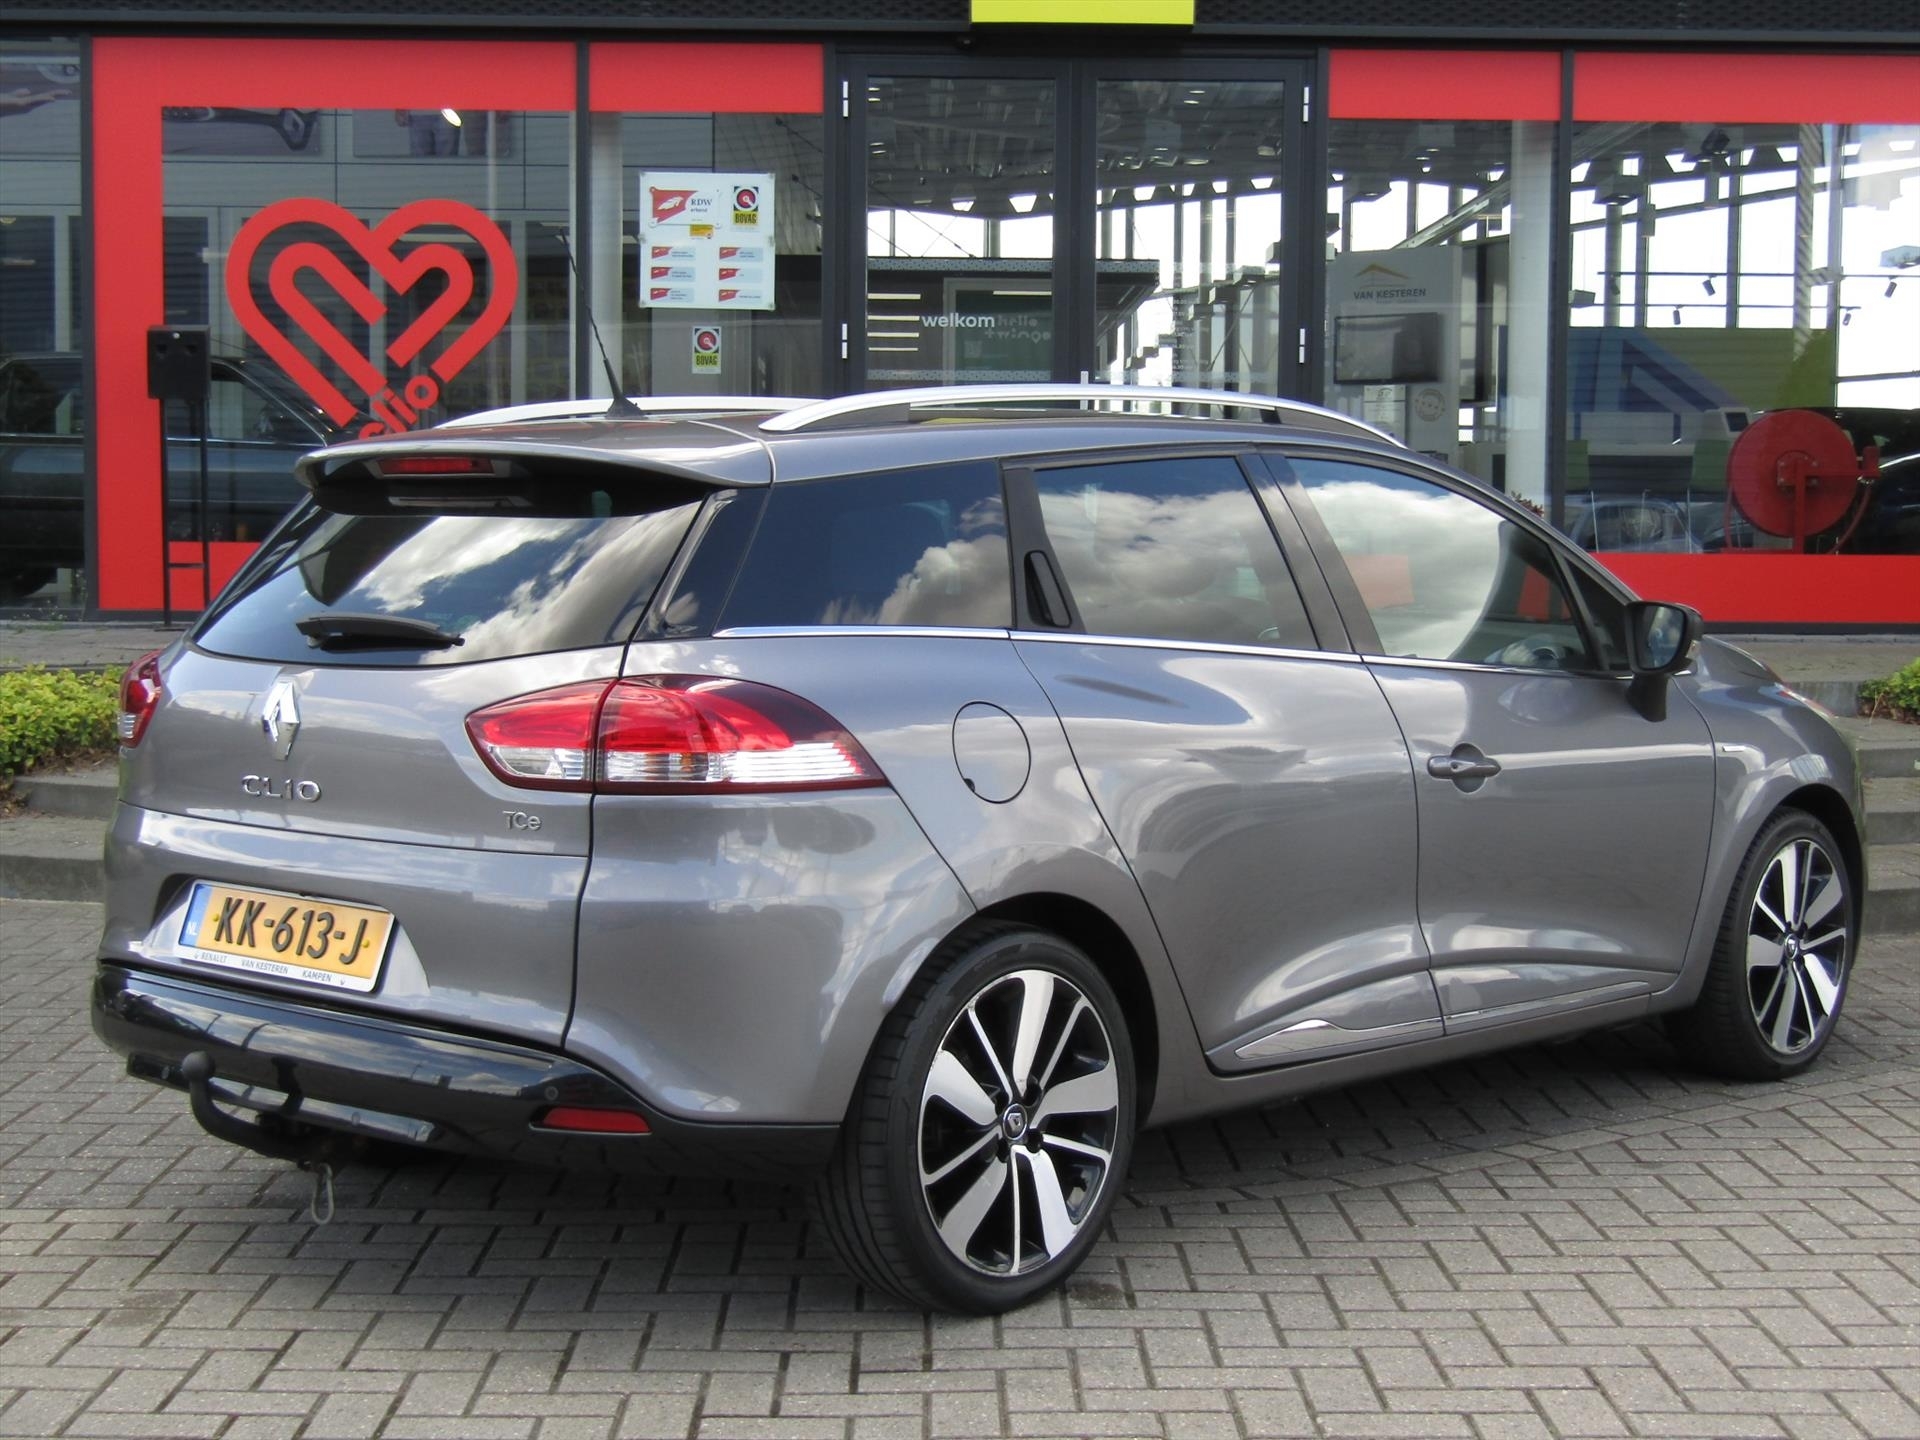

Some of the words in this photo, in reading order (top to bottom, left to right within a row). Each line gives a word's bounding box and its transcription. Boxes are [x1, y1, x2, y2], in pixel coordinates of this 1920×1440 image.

[690, 198, 712, 206] RDW
[734, 213, 758, 224] BOVAG
[1353, 290, 1374, 300] VAN
[1376, 287, 1427, 298] KESTEREN
[921, 312, 996, 328] welkom
[695, 354, 719, 366] BOVAG
[241, 774, 322, 803] CLIO
[502, 810, 542, 832] TCe
[186, 922, 198, 936] NL
[213, 896, 368, 966] KK-613-J
[241, 959, 257, 969] VAN
[256, 962, 289, 975] KESTEREN
[302, 970, 332, 982] KAMPEN
